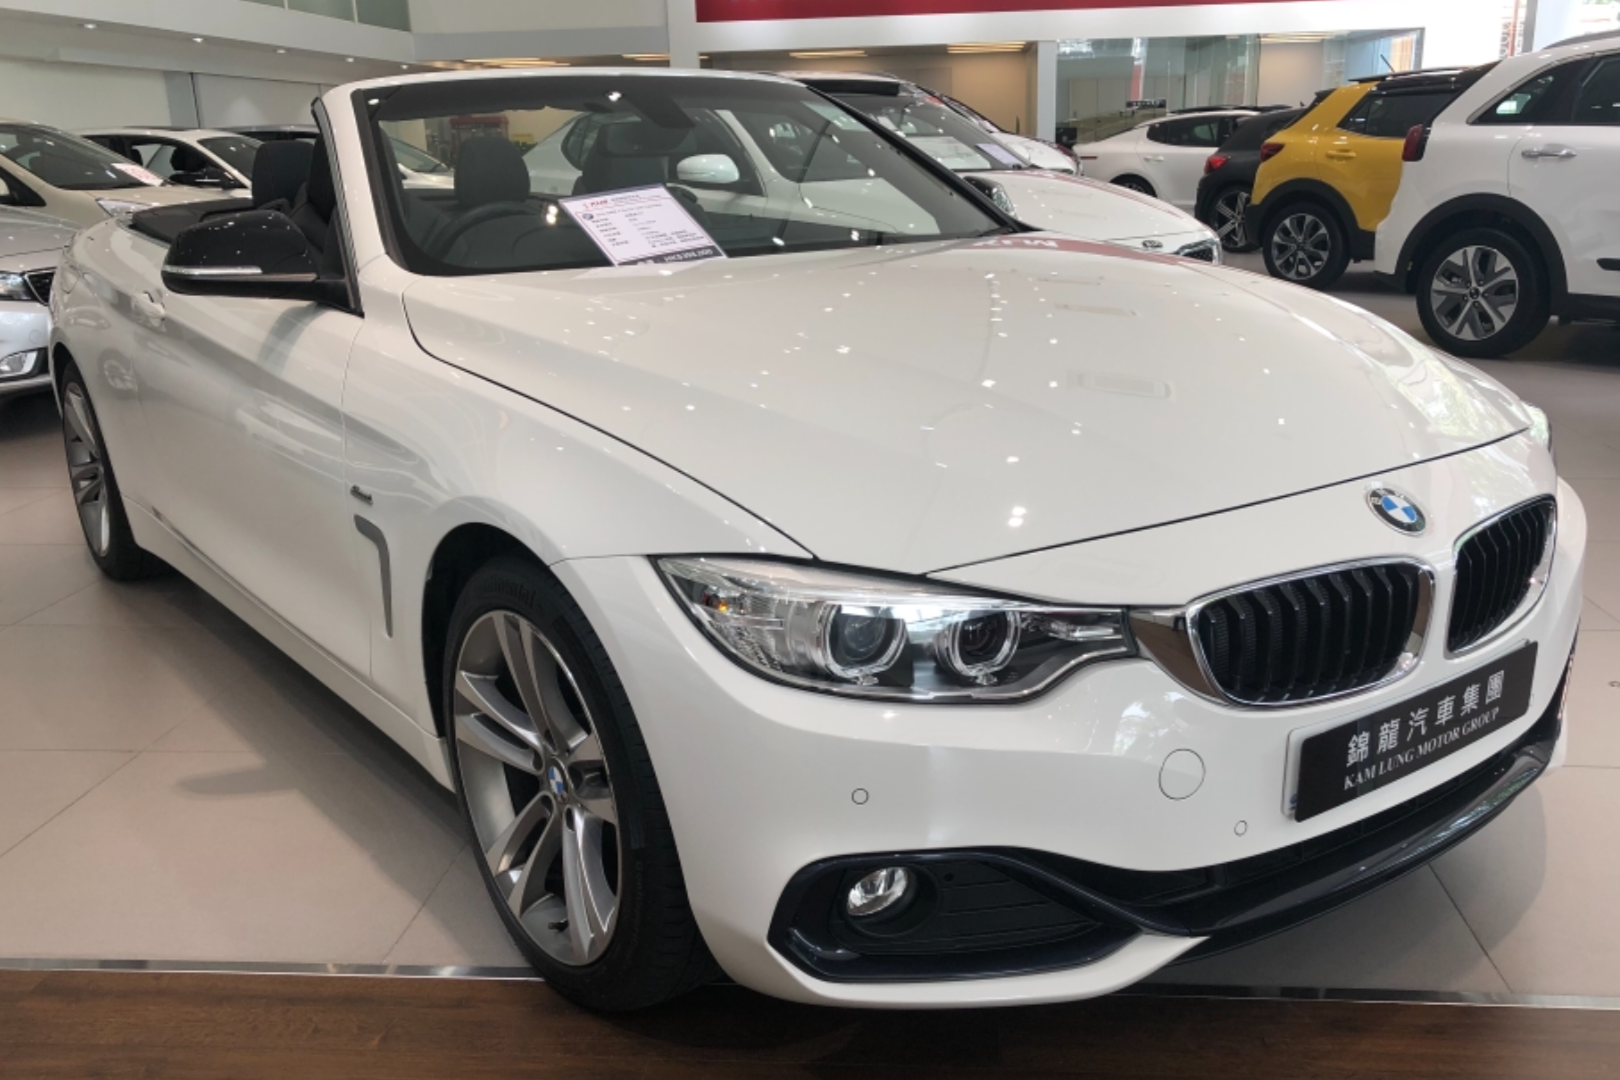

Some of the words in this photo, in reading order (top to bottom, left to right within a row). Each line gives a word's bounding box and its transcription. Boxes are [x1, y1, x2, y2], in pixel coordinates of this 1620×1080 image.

[1344, 762, 1376, 790] KAM
[1379, 748, 1414, 777] LUNG
[1416, 730, 1460, 759] MOTOR
[1462, 707, 1500, 735] GROUP
[1345, 670, 1505, 767] 錦龍汽車集團
